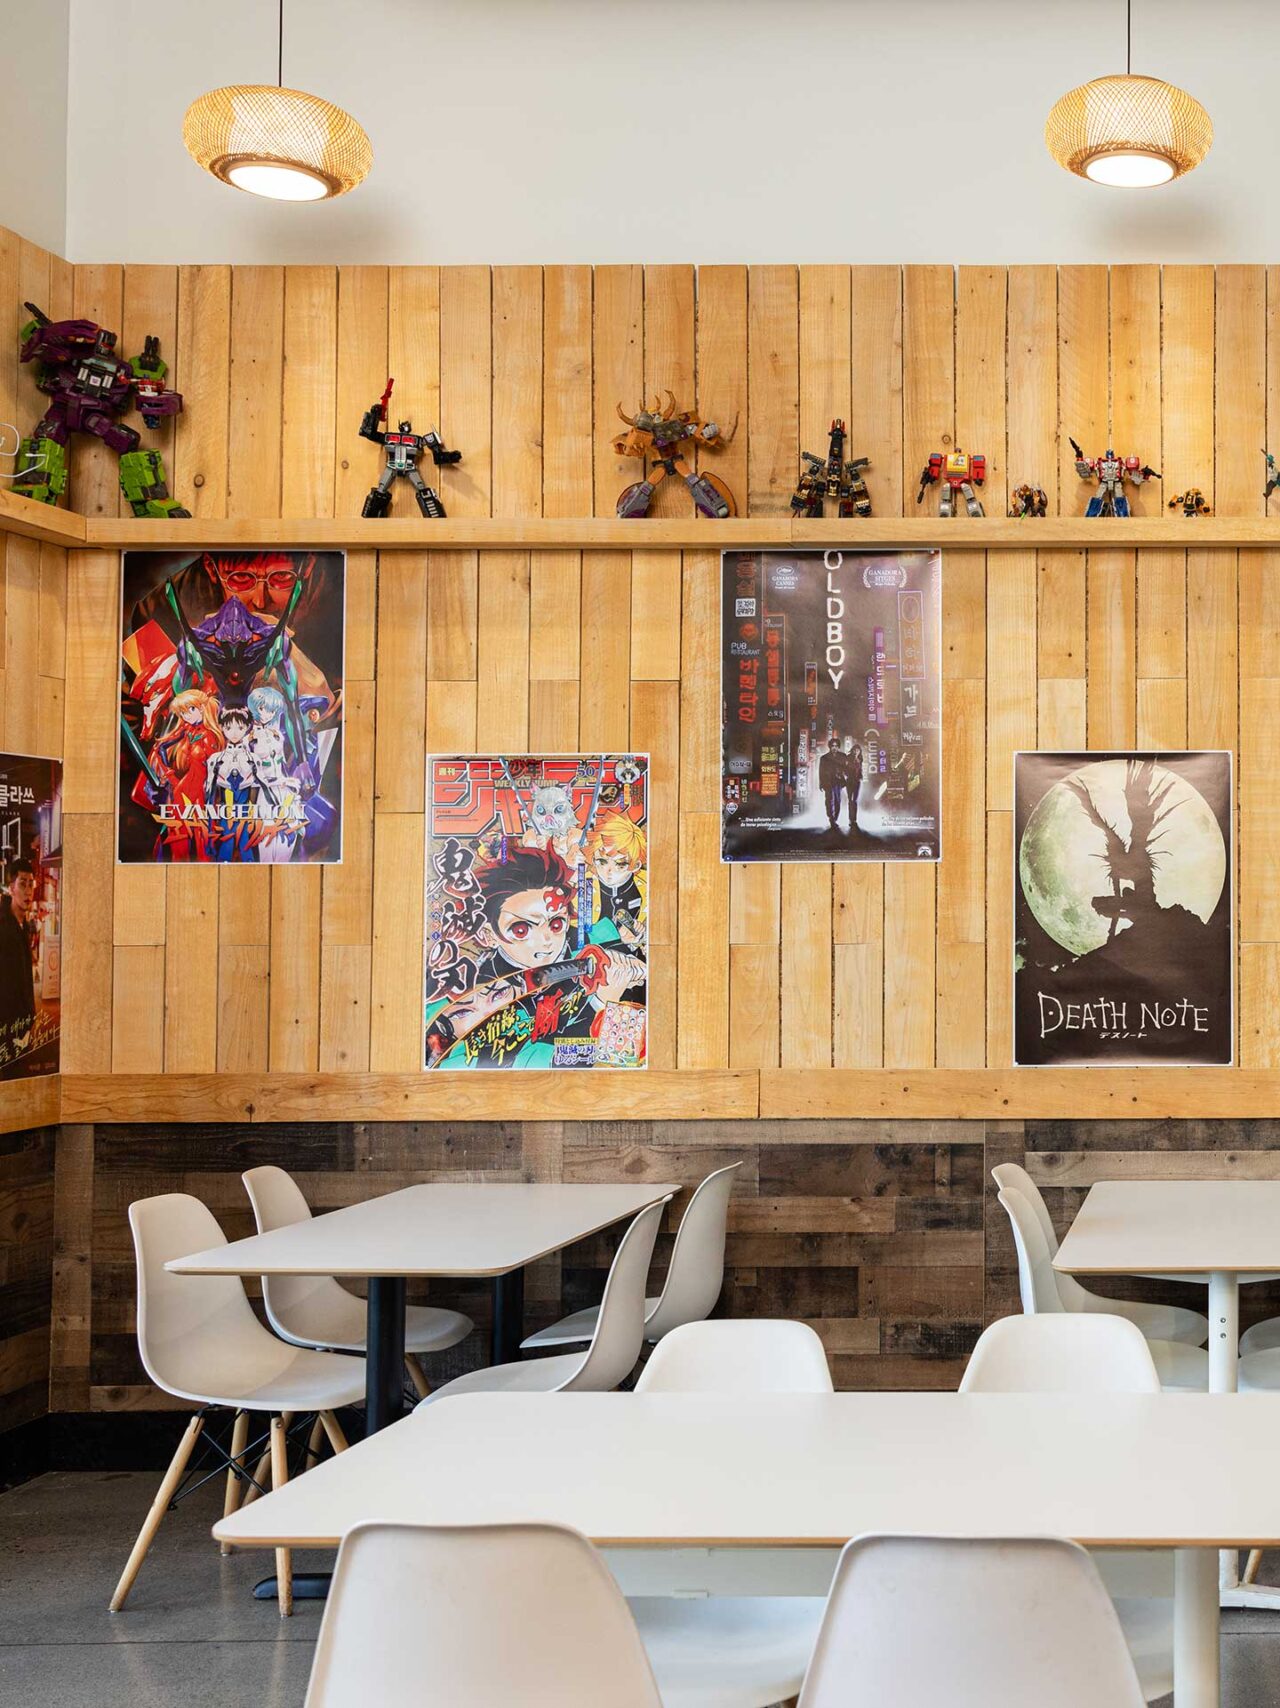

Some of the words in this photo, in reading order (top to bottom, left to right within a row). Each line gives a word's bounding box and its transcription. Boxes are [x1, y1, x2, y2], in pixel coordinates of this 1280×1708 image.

[824, 549, 844, 690] OLDBOY
[731, 642, 747, 650] PUB
[576, 764, 596, 778] 50
[494, 778, 531, 788] WEKLY
[159, 803, 308, 820] EVANGELION
[1037, 991, 1127, 1039] DEATH
[1140, 997, 1209, 1032] NOTE
